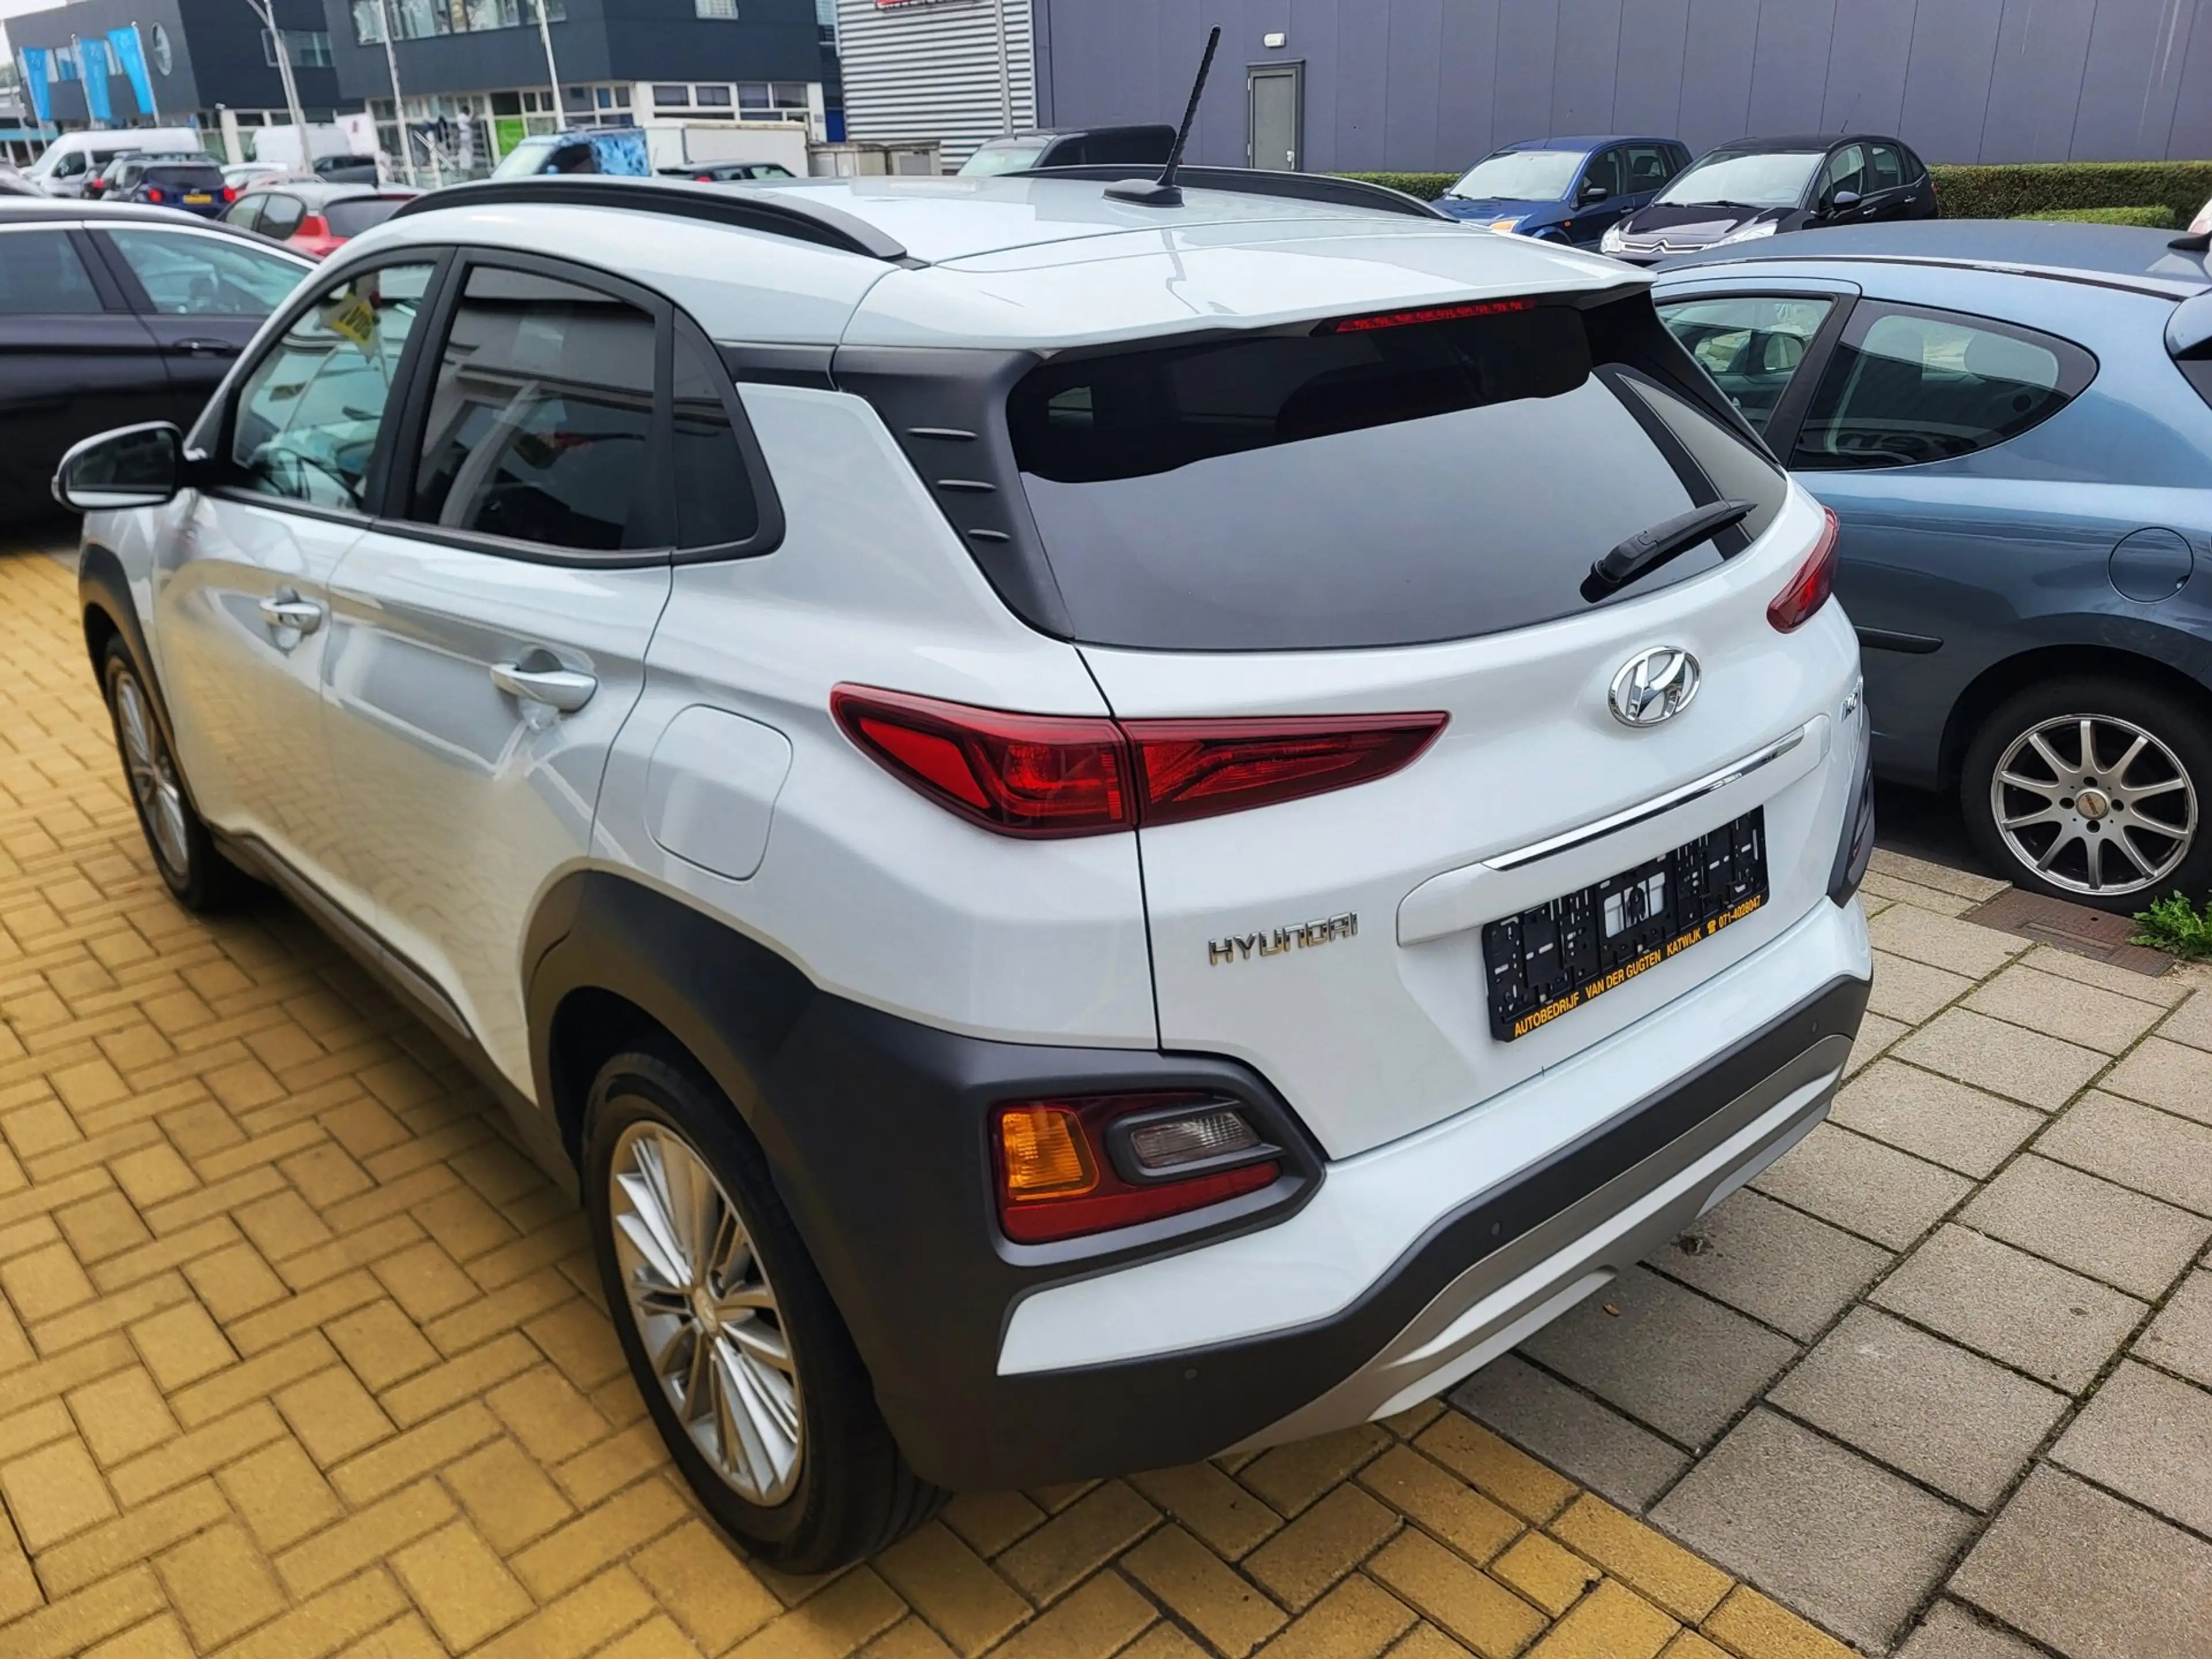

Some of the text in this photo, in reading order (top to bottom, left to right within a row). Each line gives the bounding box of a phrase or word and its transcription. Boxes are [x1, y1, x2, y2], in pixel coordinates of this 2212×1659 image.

[1208, 911, 1358, 965] HYUNDAI
[1514, 991, 1580, 1037] AUTOBEDRIJF
[1585, 980, 1604, 999] VAN
[1606, 969, 1624, 989] DER
[1626, 949, 1661, 983] GUGTEN
[1666, 927, 1702, 957] KATWIJK
